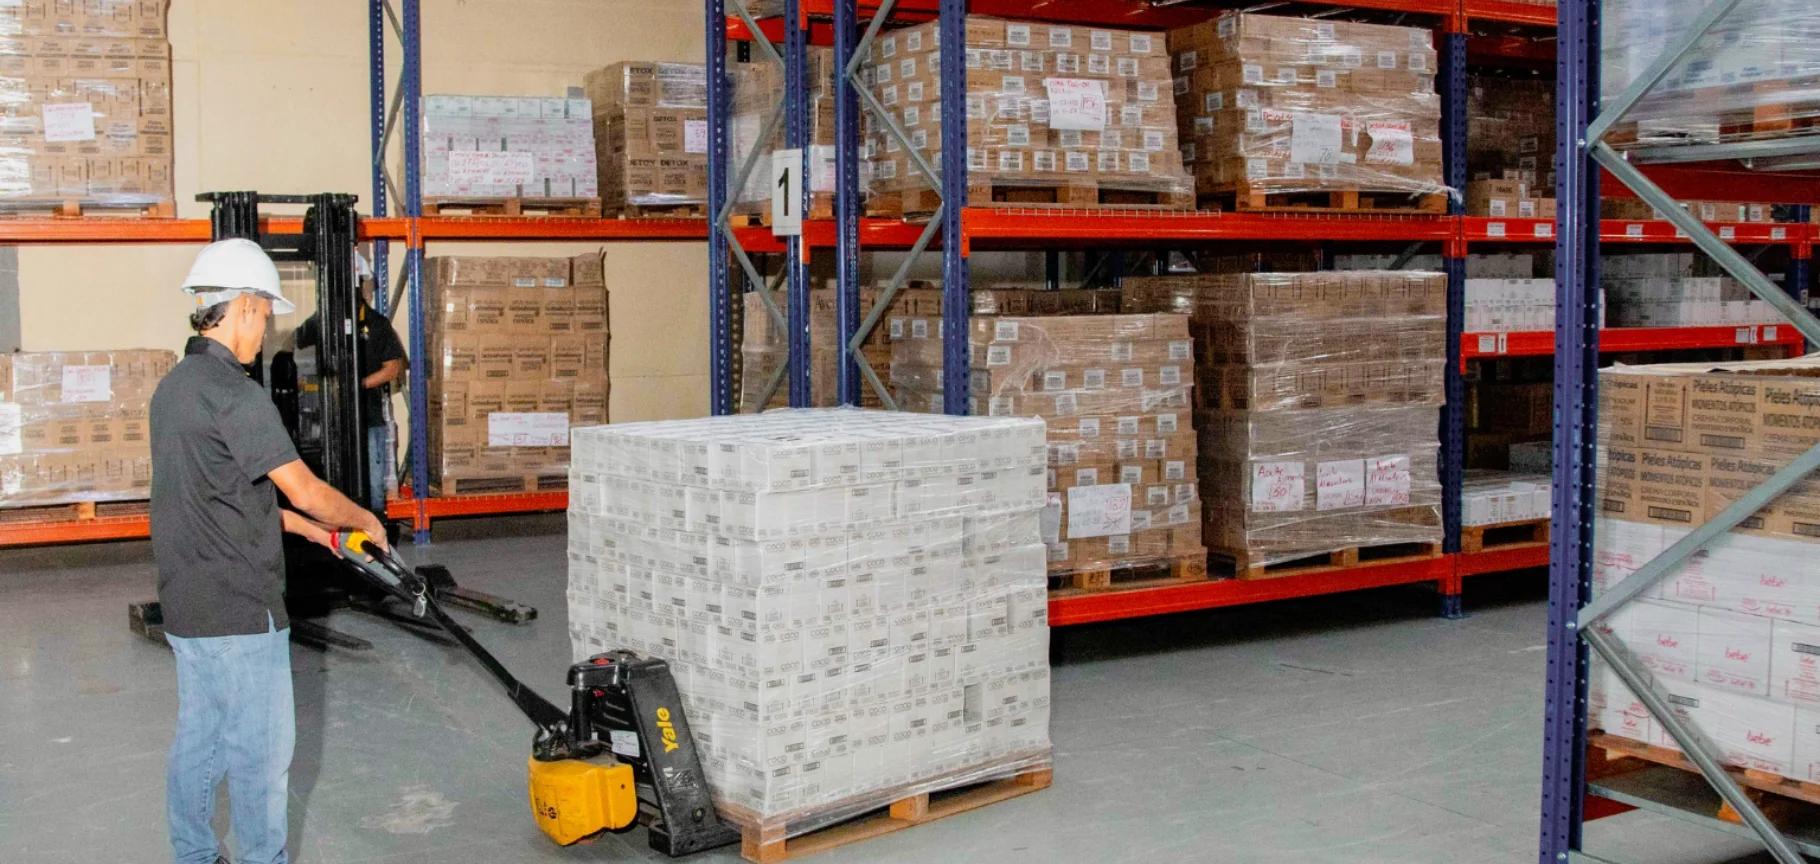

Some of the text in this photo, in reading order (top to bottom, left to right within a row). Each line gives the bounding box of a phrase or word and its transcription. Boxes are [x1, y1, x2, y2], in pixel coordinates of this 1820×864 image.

[778, 167, 789, 216] 1
[1693, 379, 1717, 393] Pieles
[1764, 388, 1791, 404] Pieles
[1692, 399, 1727, 411] MOMENTOS
[1762, 413, 1801, 429] MOMENTOS
[1641, 452, 1666, 466] Pieles
[1711, 457, 1736, 472] Pieles
[1640, 471, 1674, 484] MOMENTOS
[1760, 574, 1785, 588] bebe
[1657, 634, 1678, 648] bebe
[1725, 647, 1749, 662] bebe
[656, 707, 679, 754] Yale
[1747, 729, 1773, 745] bebe
